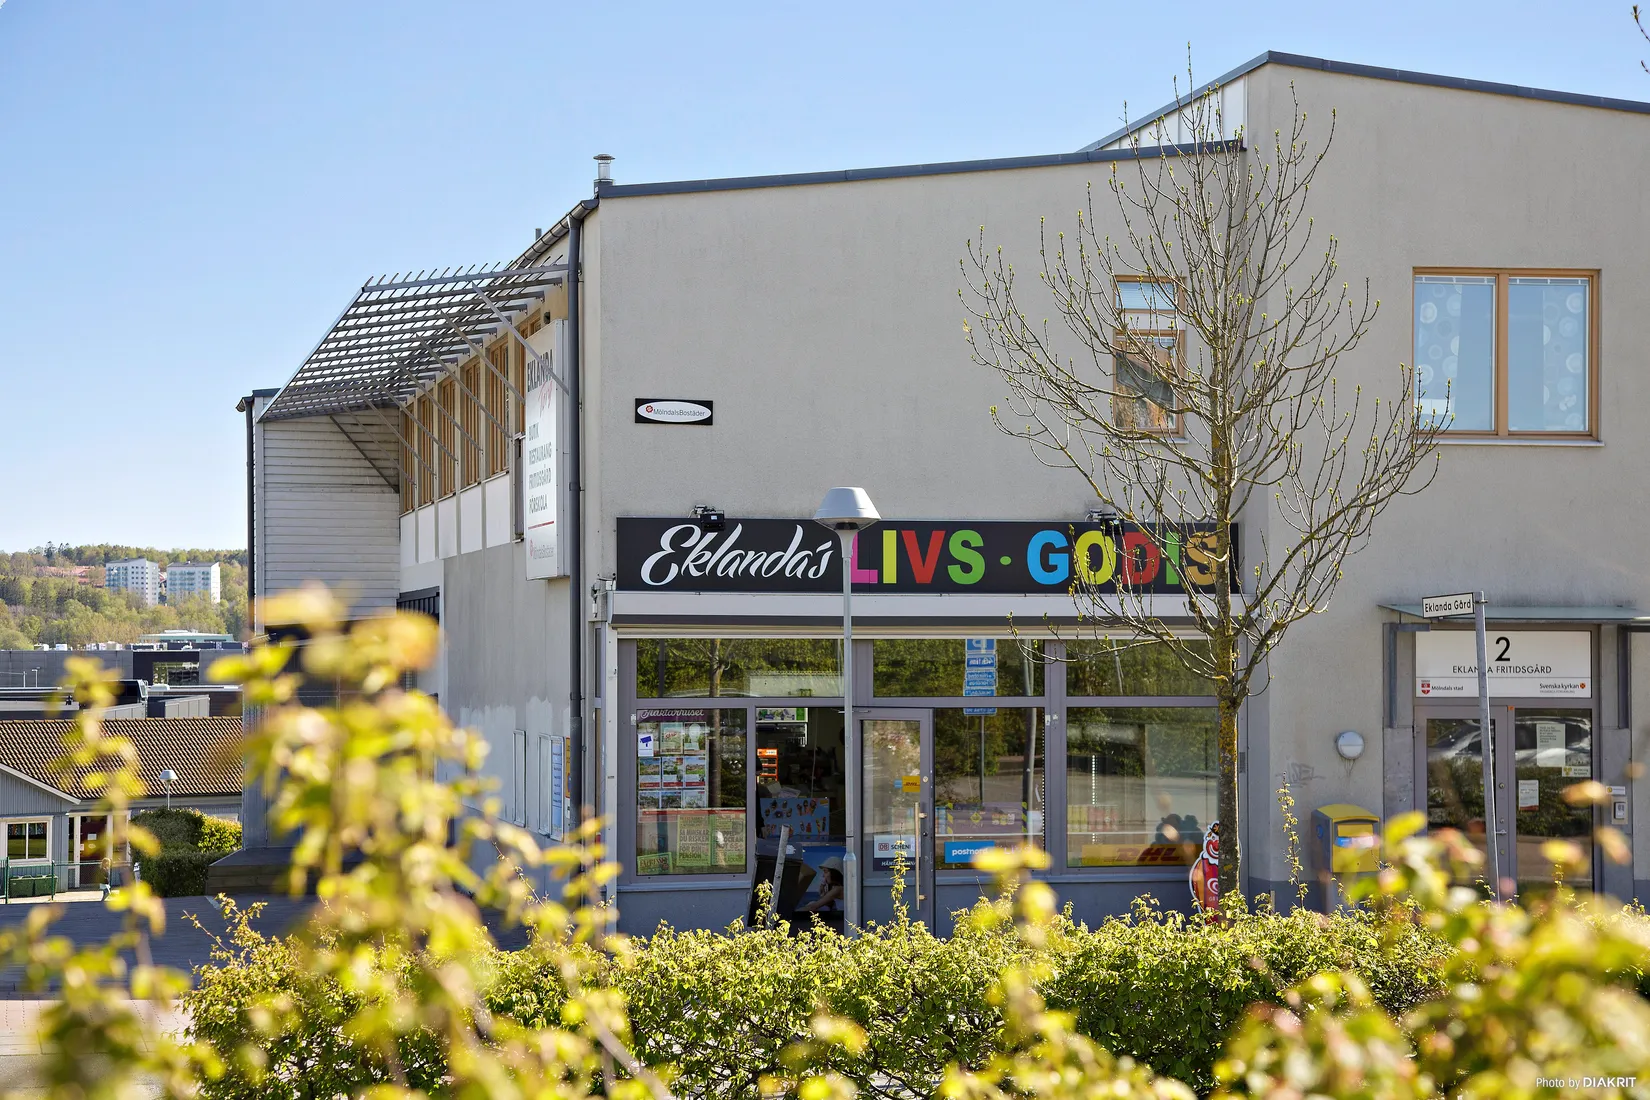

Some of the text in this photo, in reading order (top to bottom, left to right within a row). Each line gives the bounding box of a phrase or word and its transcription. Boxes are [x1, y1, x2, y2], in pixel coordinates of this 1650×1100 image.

[653, 408, 706, 417] MölndalsBostäder
[851, 530, 986, 585] LIVS
[1026, 530, 1217, 585] GODIS
[1425, 599, 1472, 612] Eklanda Gård
[1495, 636, 1511, 662] 2
[1452, 664, 1552, 674] EKLANA FRITIDSGÅRD
[1116, 847, 1181, 862] DHL
